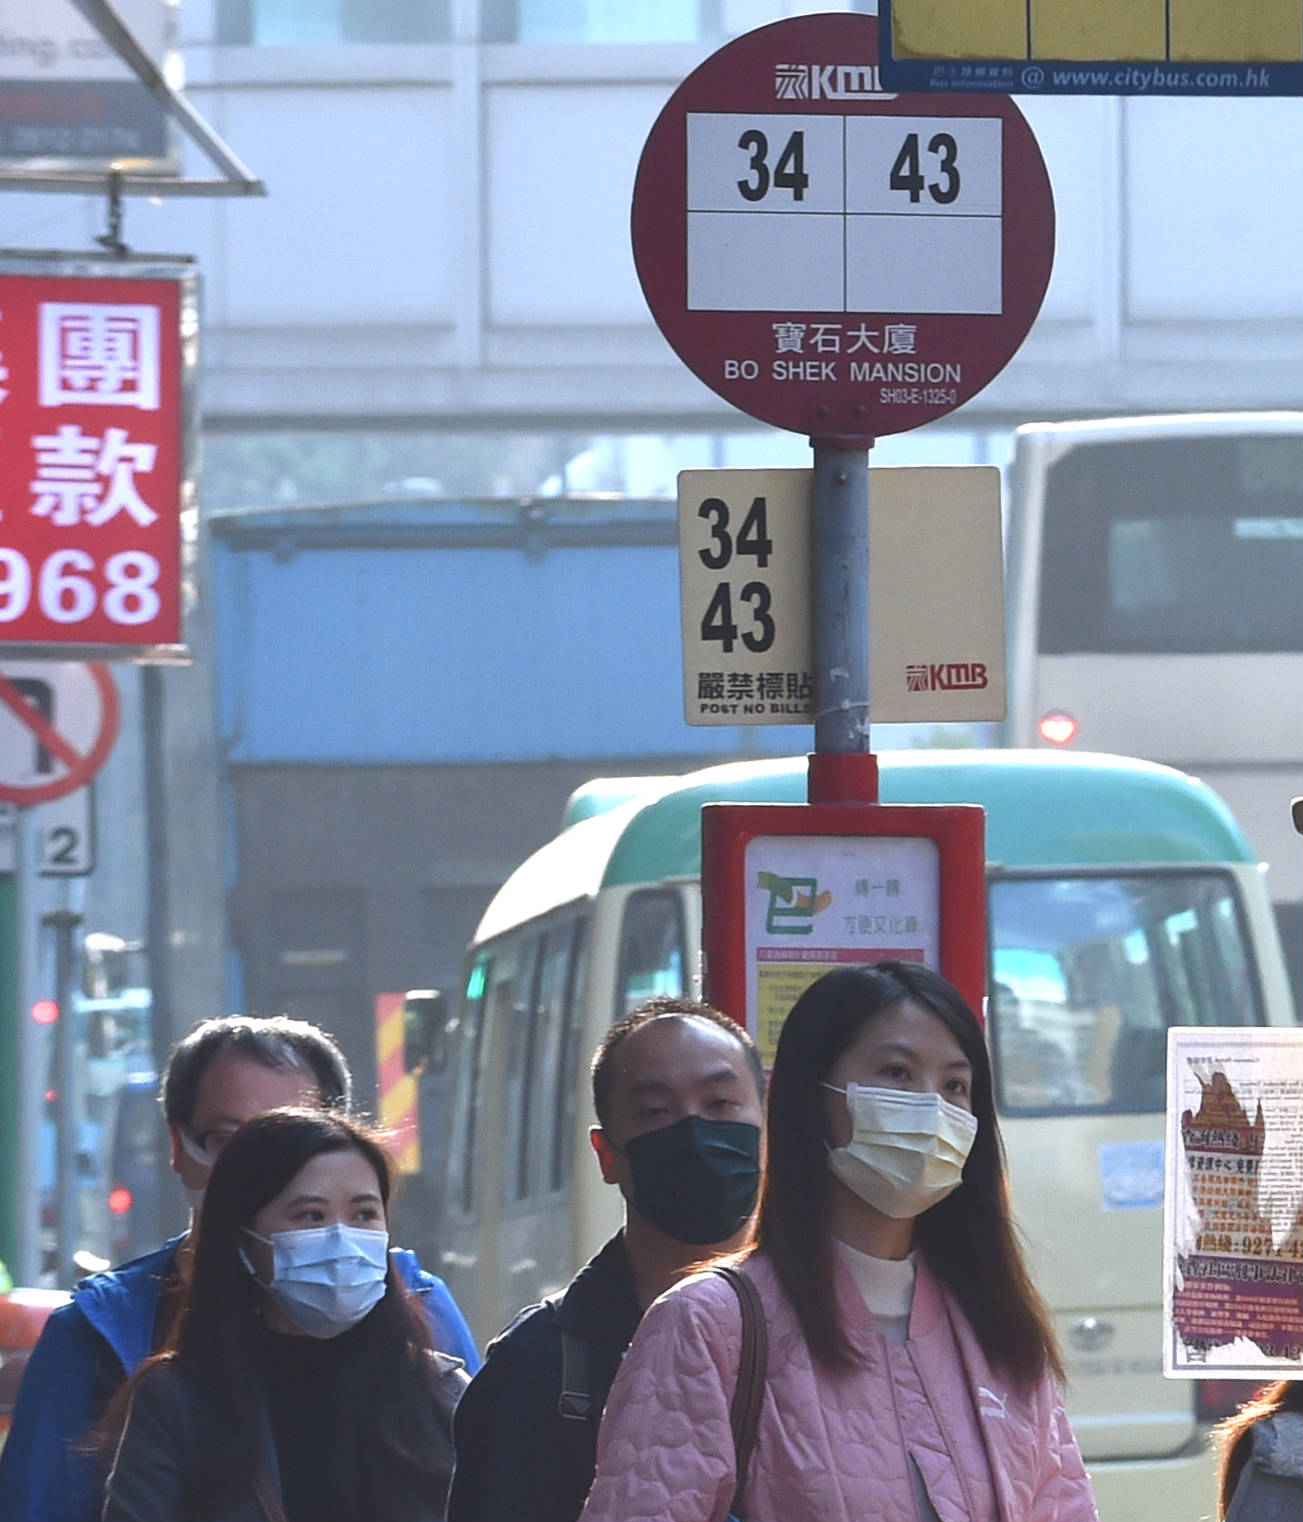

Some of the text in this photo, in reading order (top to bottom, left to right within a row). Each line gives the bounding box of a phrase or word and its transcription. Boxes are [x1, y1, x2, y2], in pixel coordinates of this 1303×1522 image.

[811, 65, 898, 99] KM
[1052, 67, 1270, 92] www.citybus.com.hk
[736, 130, 809, 202] 34
[889, 132, 961, 204] 43
[772, 322, 918, 354] 寶石大廈
[725, 360, 961, 383] BO SHEK MANSION
[698, 497, 772, 570] 34
[701, 581, 776, 654] 43
[698, 672, 814, 701] 嚴禁標貼
[930, 663, 988, 690] KMB
[700, 704, 738, 714] POST
[744, 704, 765, 714] NO
